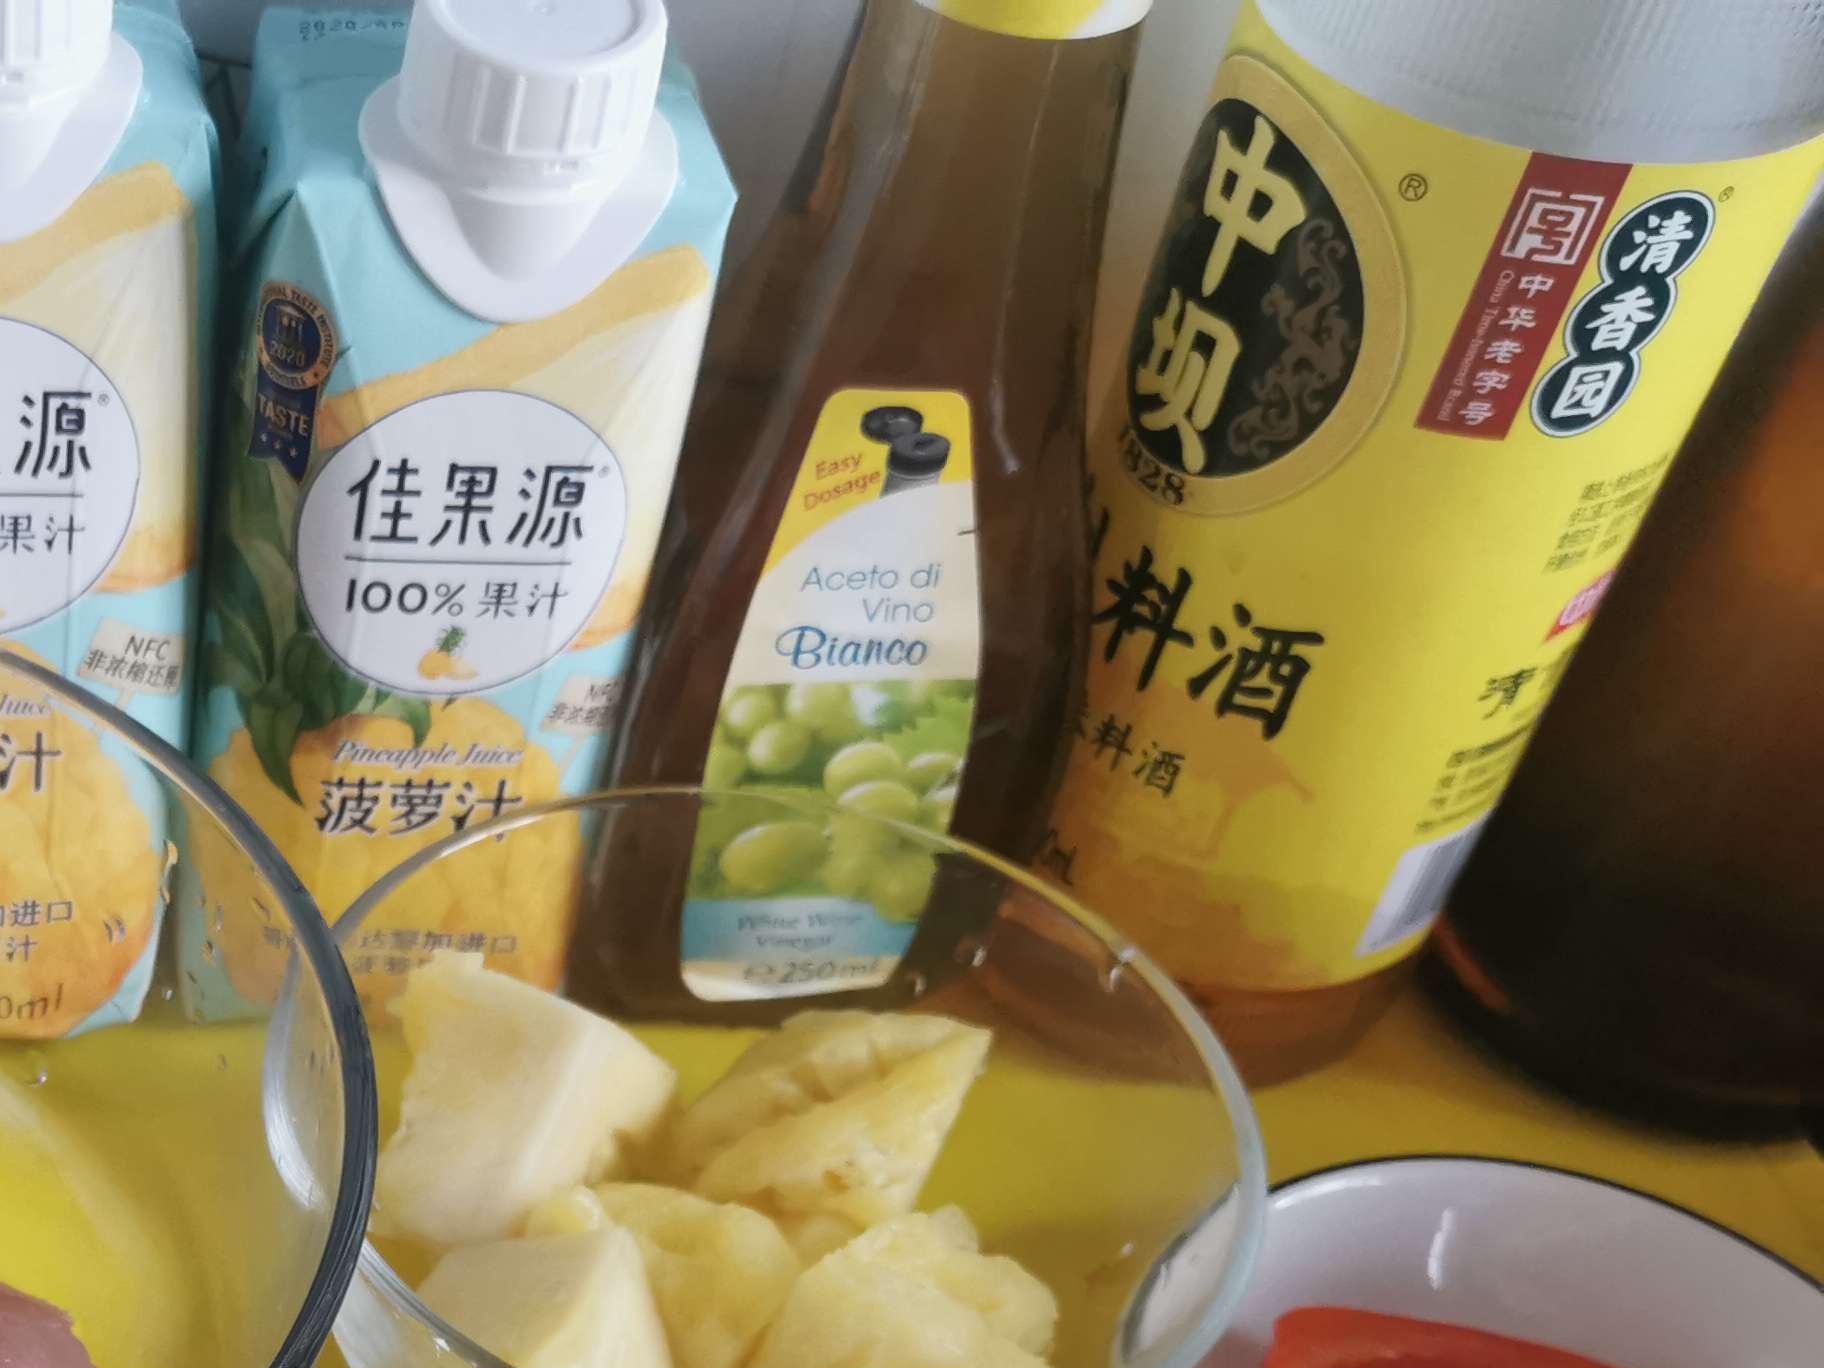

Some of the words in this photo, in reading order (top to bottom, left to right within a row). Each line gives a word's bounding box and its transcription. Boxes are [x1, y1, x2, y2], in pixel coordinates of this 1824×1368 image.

[1135, 115, 1307, 475] 中坝
[1550, 212, 1695, 421] 清香园
[1458, 272, 1555, 427] 中华老字号
[815, 453, 863, 480] Easy
[347, 459, 594, 548] 佳果源
[803, 471, 881, 512] Dosage
[801, 564, 899, 592] Aceto
[911, 563, 942, 590] di
[862, 597, 934, 623] Vino
[1083, 473, 1325, 741] 料酒
[124, 635, 171, 661] NFC
[776, 625, 928, 670] Bianco
[333, 739, 458, 770] Pineapple
[460, 743, 524, 765] Juice
[314, 776, 524, 842] 菠萝汁
